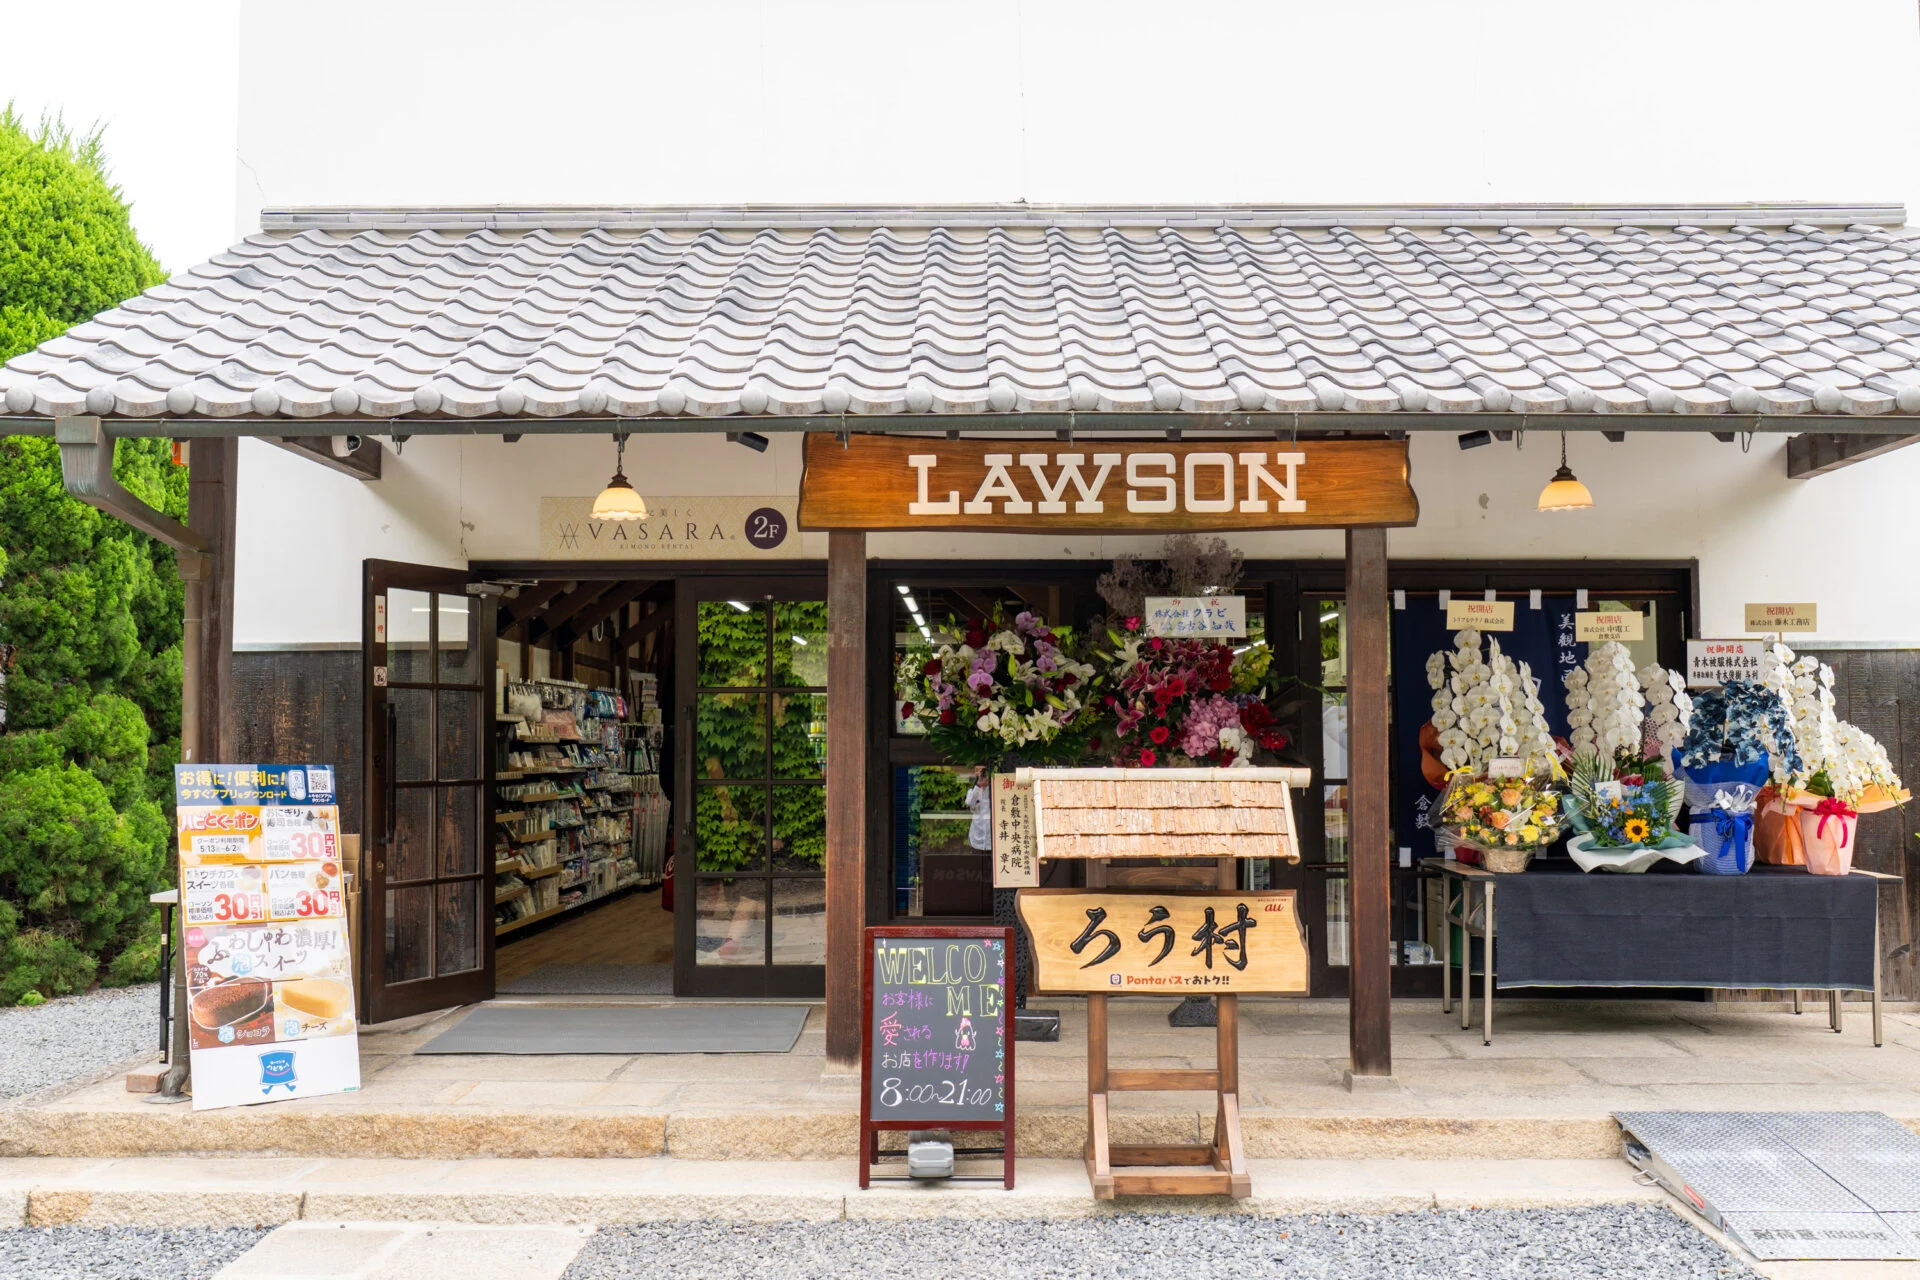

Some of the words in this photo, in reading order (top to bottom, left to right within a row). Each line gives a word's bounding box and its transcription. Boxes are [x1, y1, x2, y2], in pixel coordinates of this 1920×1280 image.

[908, 452, 1307, 515] LAWSON
[587, 522, 725, 541] VASARA
[753, 515, 780, 539] 2F
[1467, 604, 1494, 614] 祝開店
[1596, 615, 1622, 624] 祝開店
[1766, 607, 1794, 615] 祝開店
[1606, 624, 1630, 632] 中電工
[1693, 656, 1758, 667] 青木被服株式会社
[1706, 645, 1744, 654] 祝御開店
[1414, 794, 1432, 829] 倉敷
[1011, 794, 1022, 868] 倉敷中央病院
[292, 832, 323, 858] 30
[214, 893, 250, 920] 30
[295, 890, 329, 916] 30
[1264, 904, 1284, 912] au
[1070, 903, 1257, 971] ろう村
[878, 944, 986, 985] WELCO
[883, 988, 933, 1010] お客様に
[946, 983, 1000, 1017] ME
[880, 1011, 932, 1046] 愛される
[882, 1048, 970, 1074] お店を作ります!
